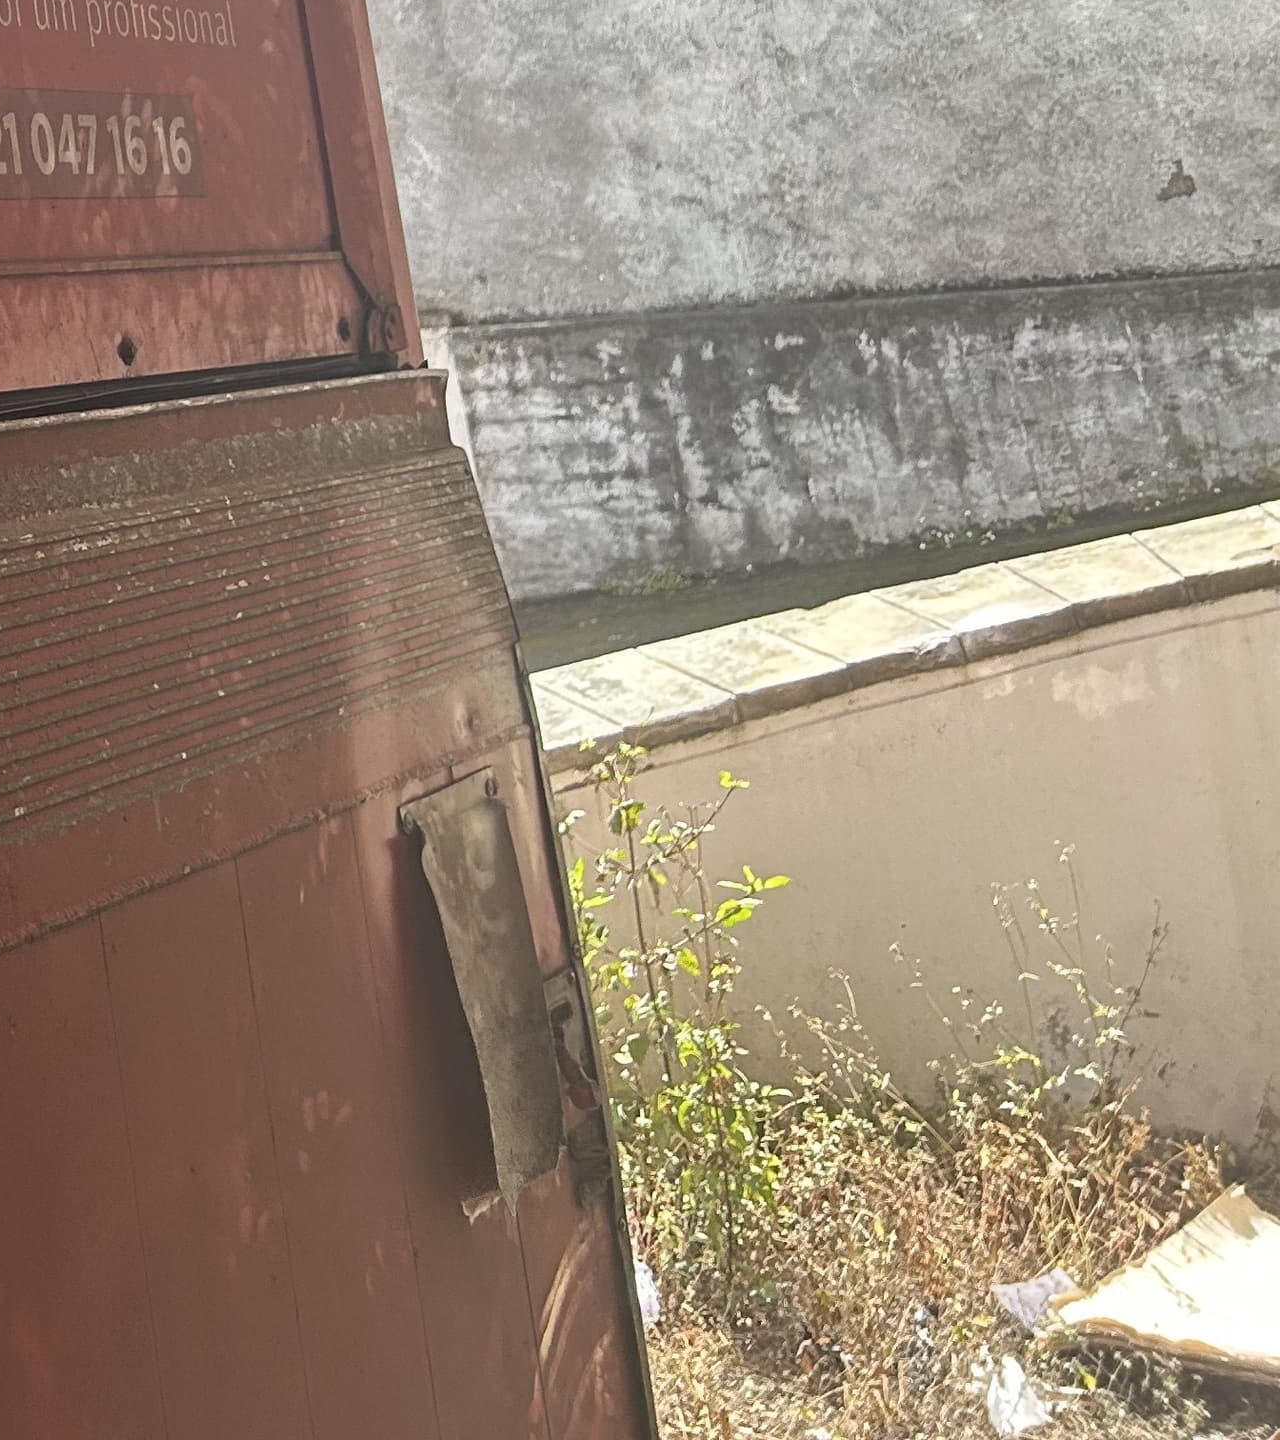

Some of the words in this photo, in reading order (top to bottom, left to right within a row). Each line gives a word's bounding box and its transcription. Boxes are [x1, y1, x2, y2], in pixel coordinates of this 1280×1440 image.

[30, 112, 97, 175] 047
[106, 114, 147, 175] 16
[152, 116, 192, 175] 16
